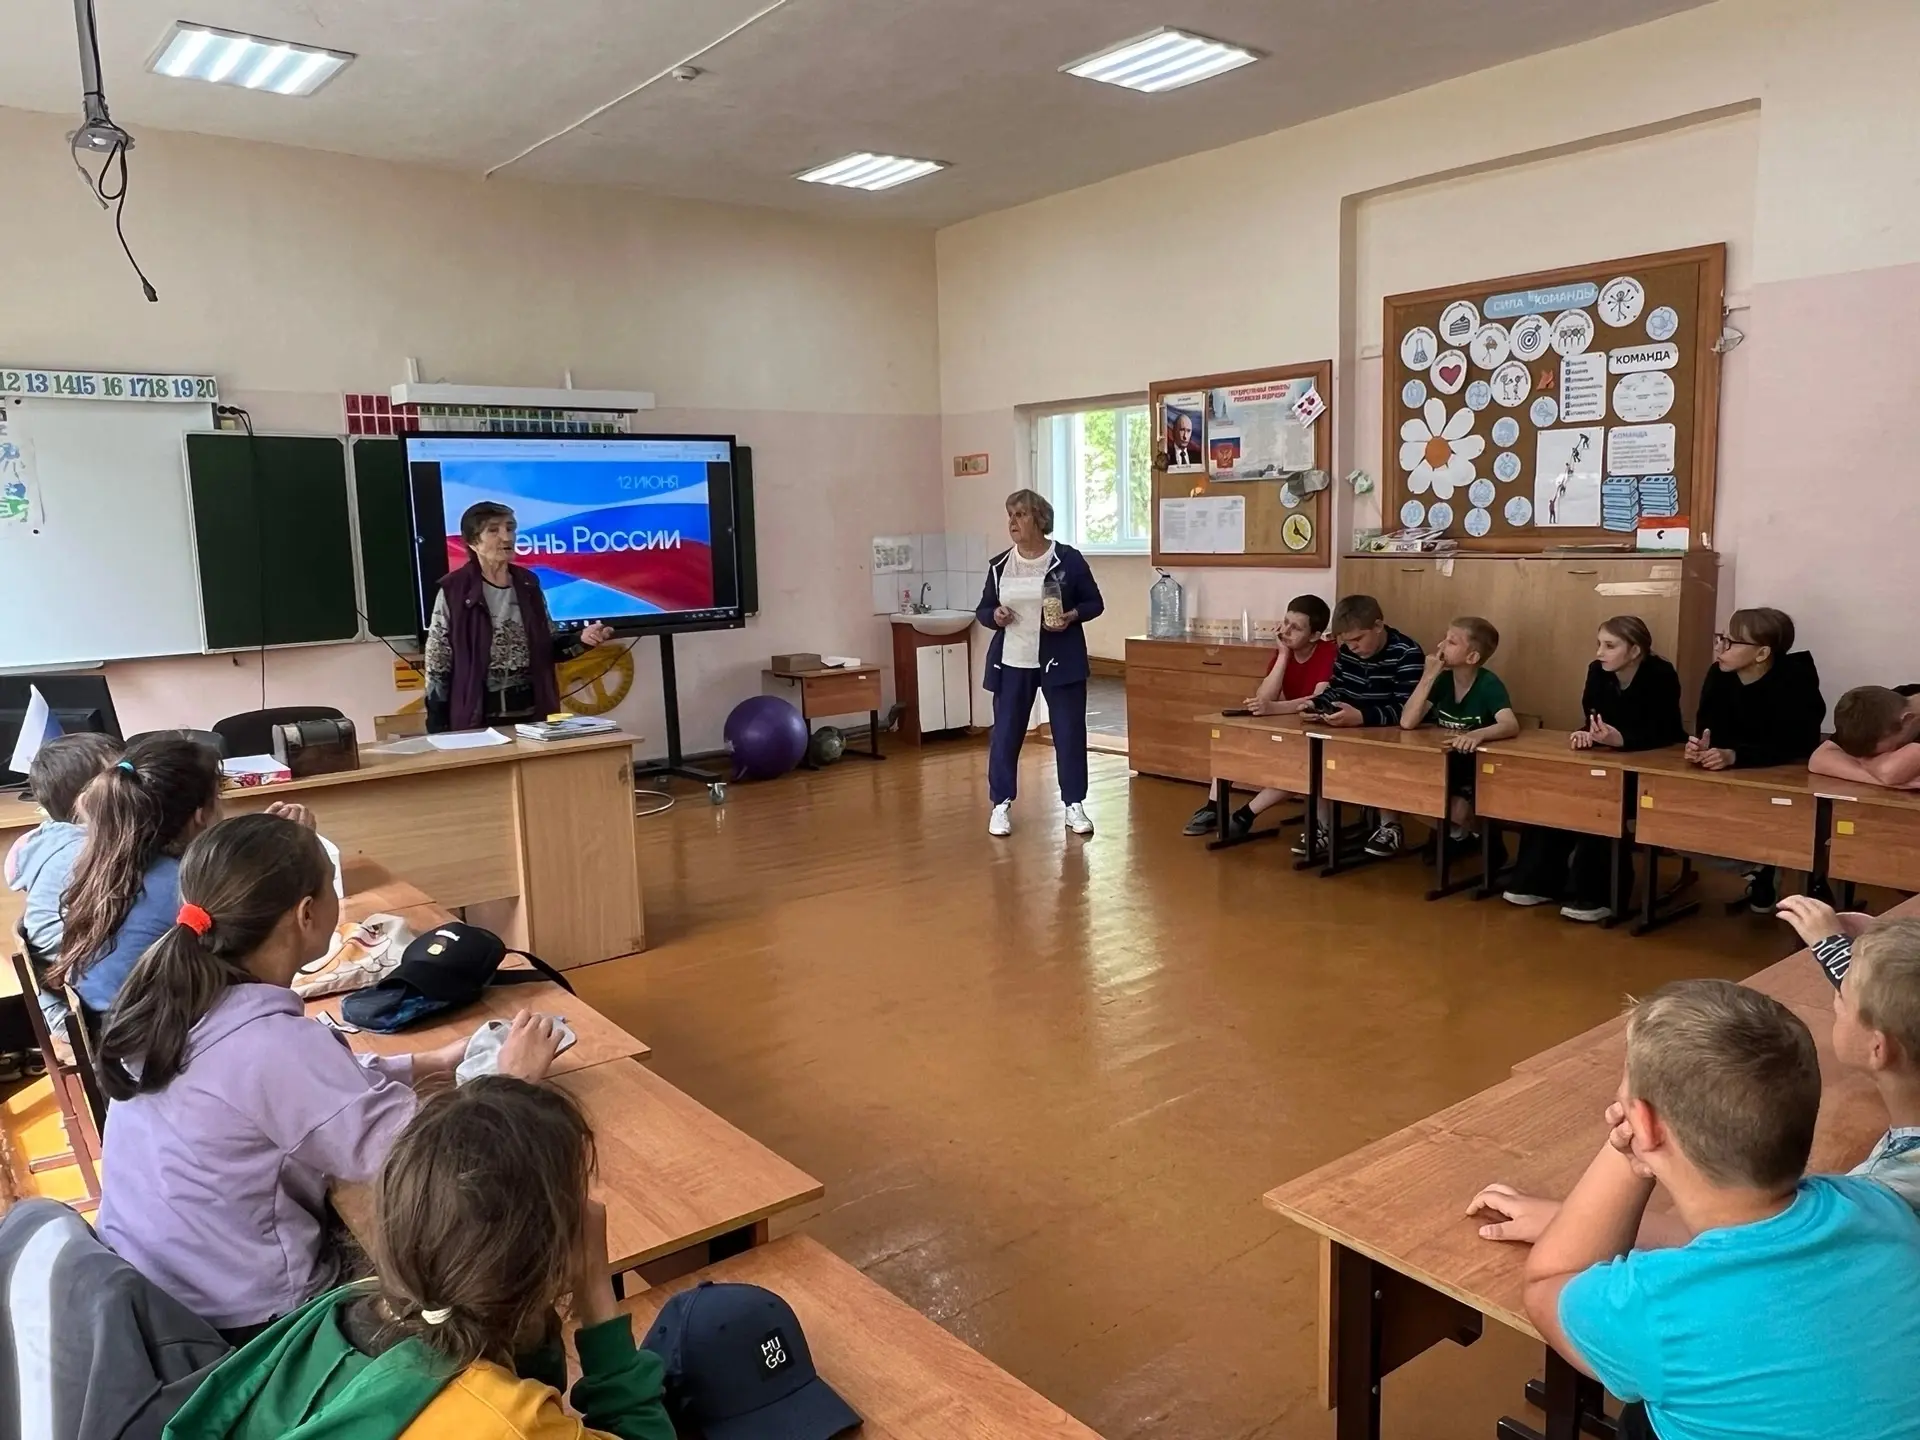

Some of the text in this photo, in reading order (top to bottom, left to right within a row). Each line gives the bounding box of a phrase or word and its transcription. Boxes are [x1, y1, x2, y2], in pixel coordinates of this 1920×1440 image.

[1616, 351, 1670, 365] КОМАНДА
[25, 372, 49, 393] 13
[53, 374, 75, 395] 14
[75, 375, 96, 395] 15
[102, 376, 124, 396] 16
[129, 378, 151, 397] 17
[150, 378, 169, 399] 18
[172, 379, 194, 398] 19
[196, 378, 217, 399] 20
[617, 475, 679, 489] 12 ИЮНЯ
[514, 525, 681, 556] ень России
